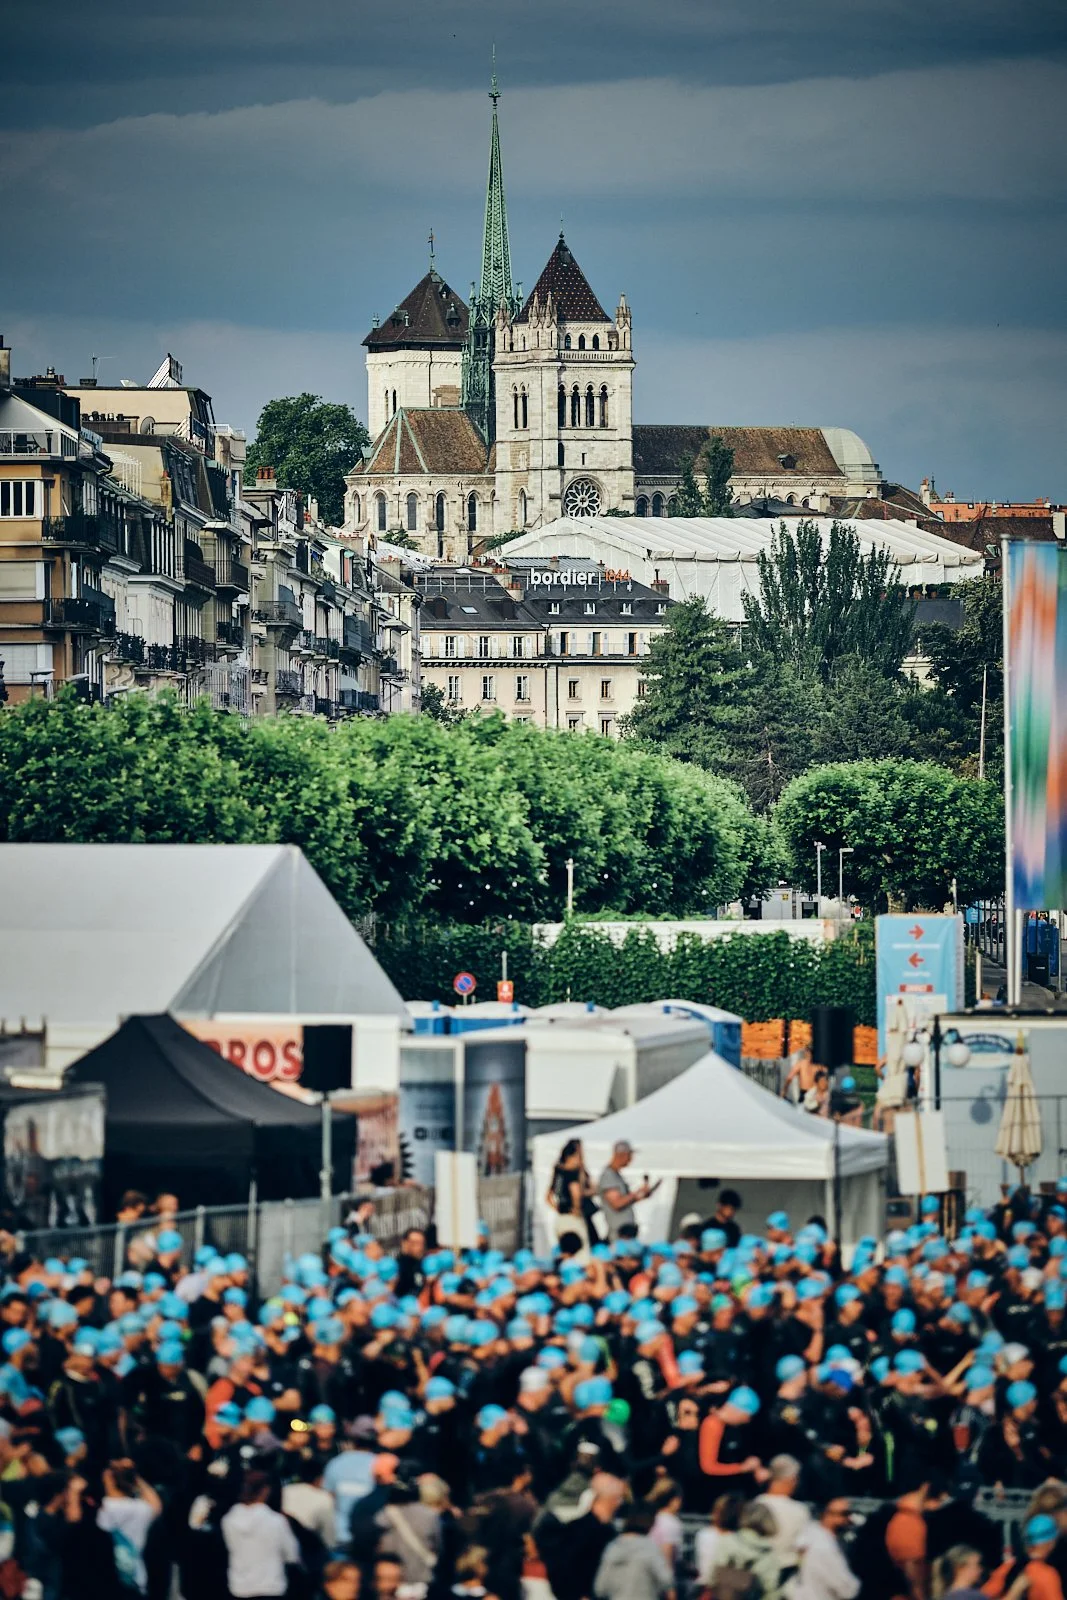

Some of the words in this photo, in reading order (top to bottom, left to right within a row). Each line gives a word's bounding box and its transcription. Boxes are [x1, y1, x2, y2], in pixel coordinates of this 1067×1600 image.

[530, 567, 596, 585] bordier
[604, 568, 631, 583] 1844
[204, 1040, 301, 1075] ROS
